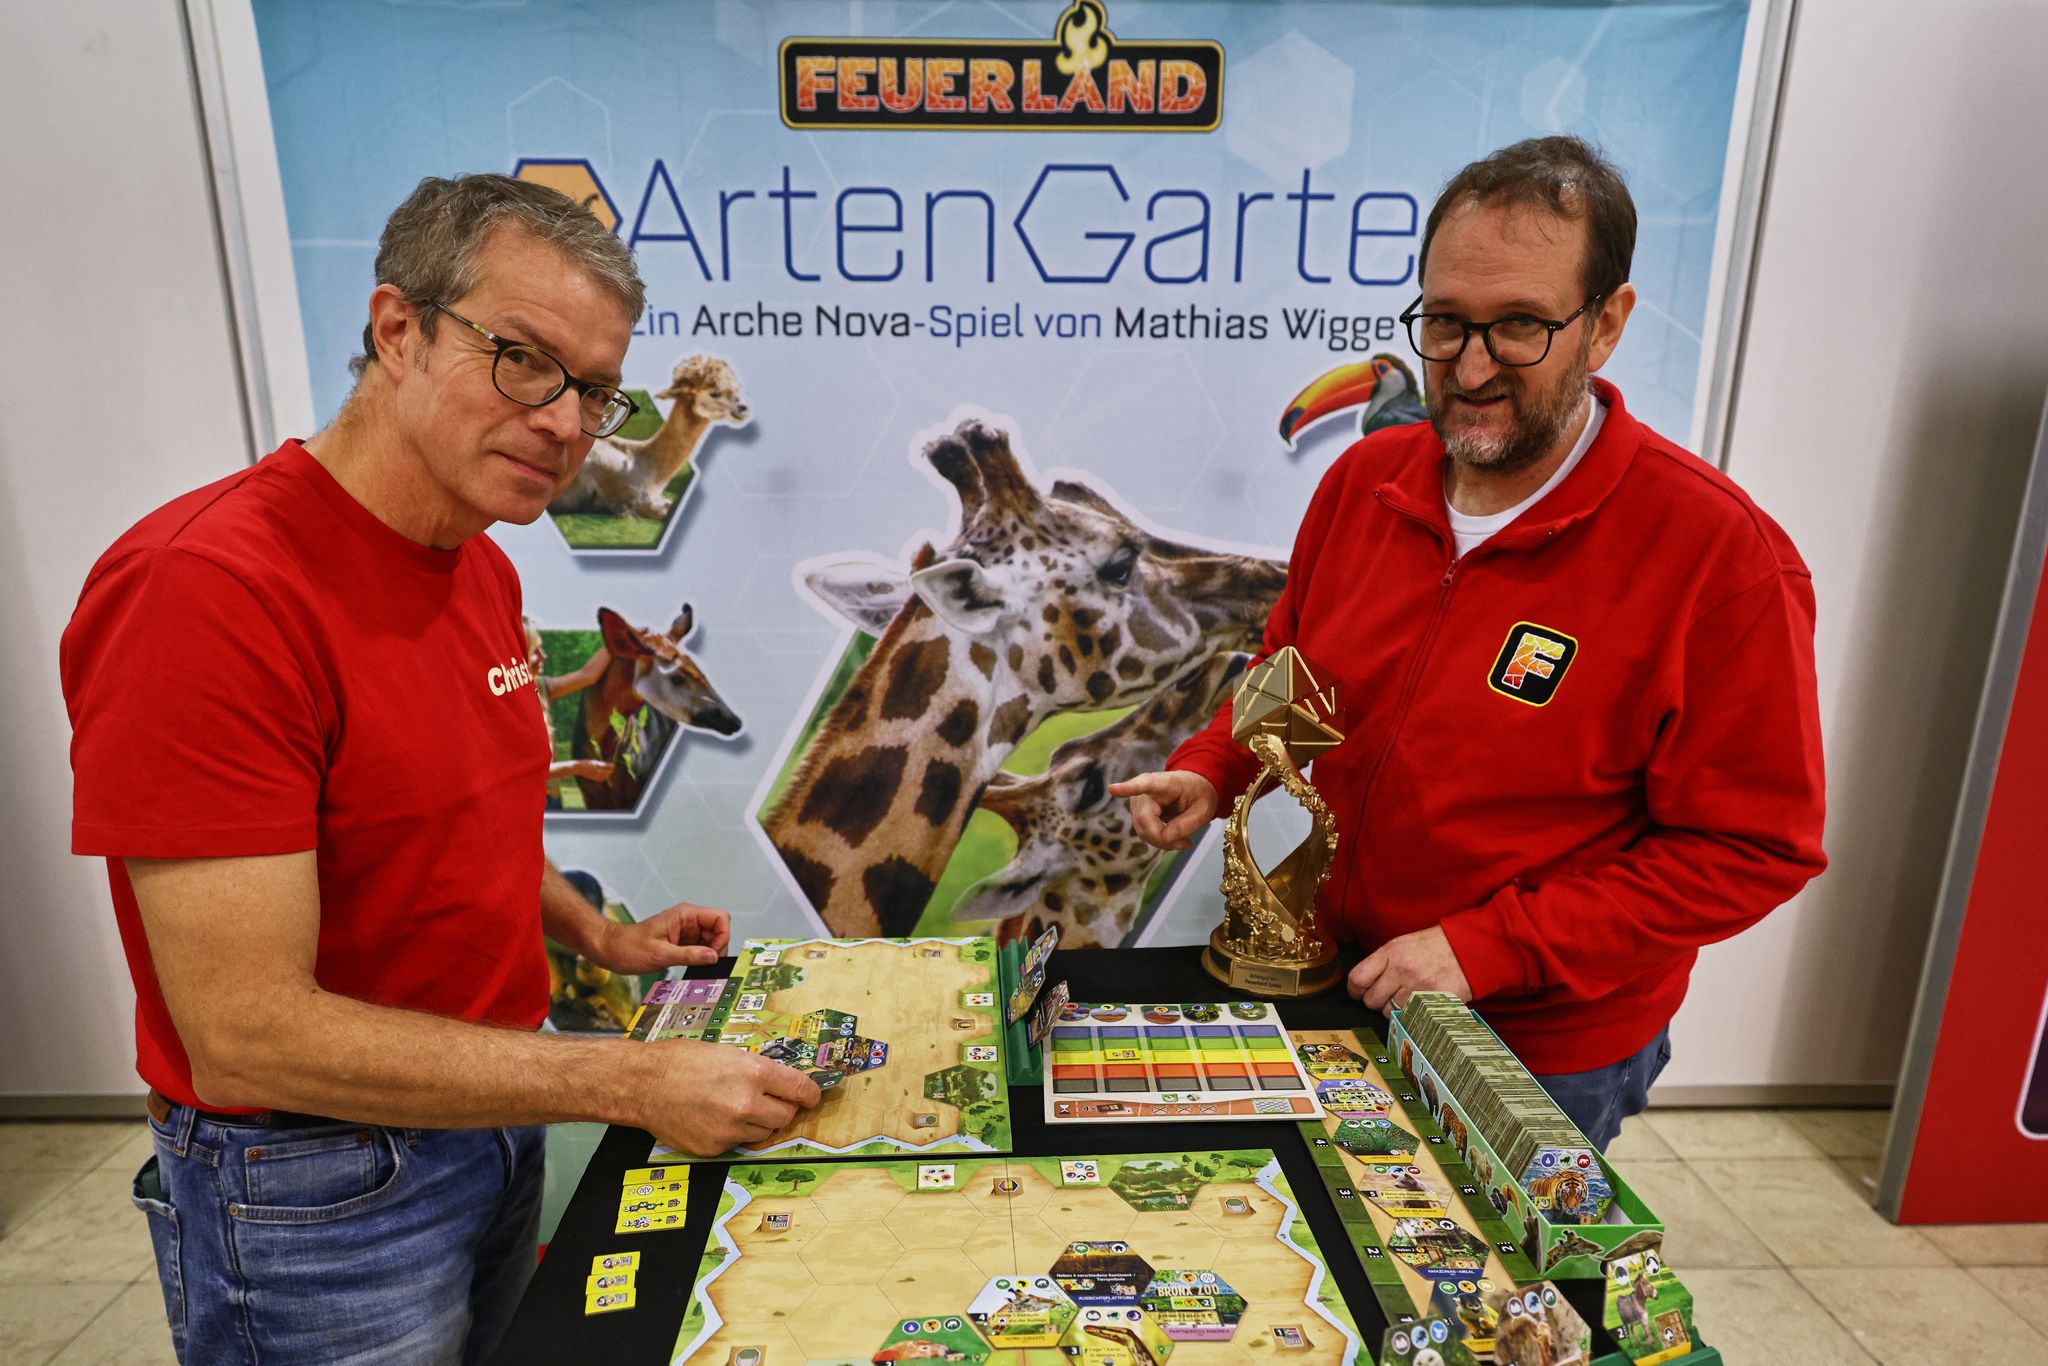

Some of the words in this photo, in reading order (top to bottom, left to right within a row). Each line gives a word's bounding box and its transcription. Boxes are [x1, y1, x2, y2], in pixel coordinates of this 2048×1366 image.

[795, 56, 1207, 114] FEUERLAND
[629, 158, 1419, 287] ArtenGarte
[691, 301, 803, 337] Arche
[815, 302, 1024, 348] Nova-Spiel
[1034, 311, 1102, 339] von
[1114, 303, 1269, 340] Mathias
[1281, 307, 1396, 352] Wigge
[1157, 1286, 1193, 1297] BRONX
[1197, 1284, 1220, 1296] ZOO
